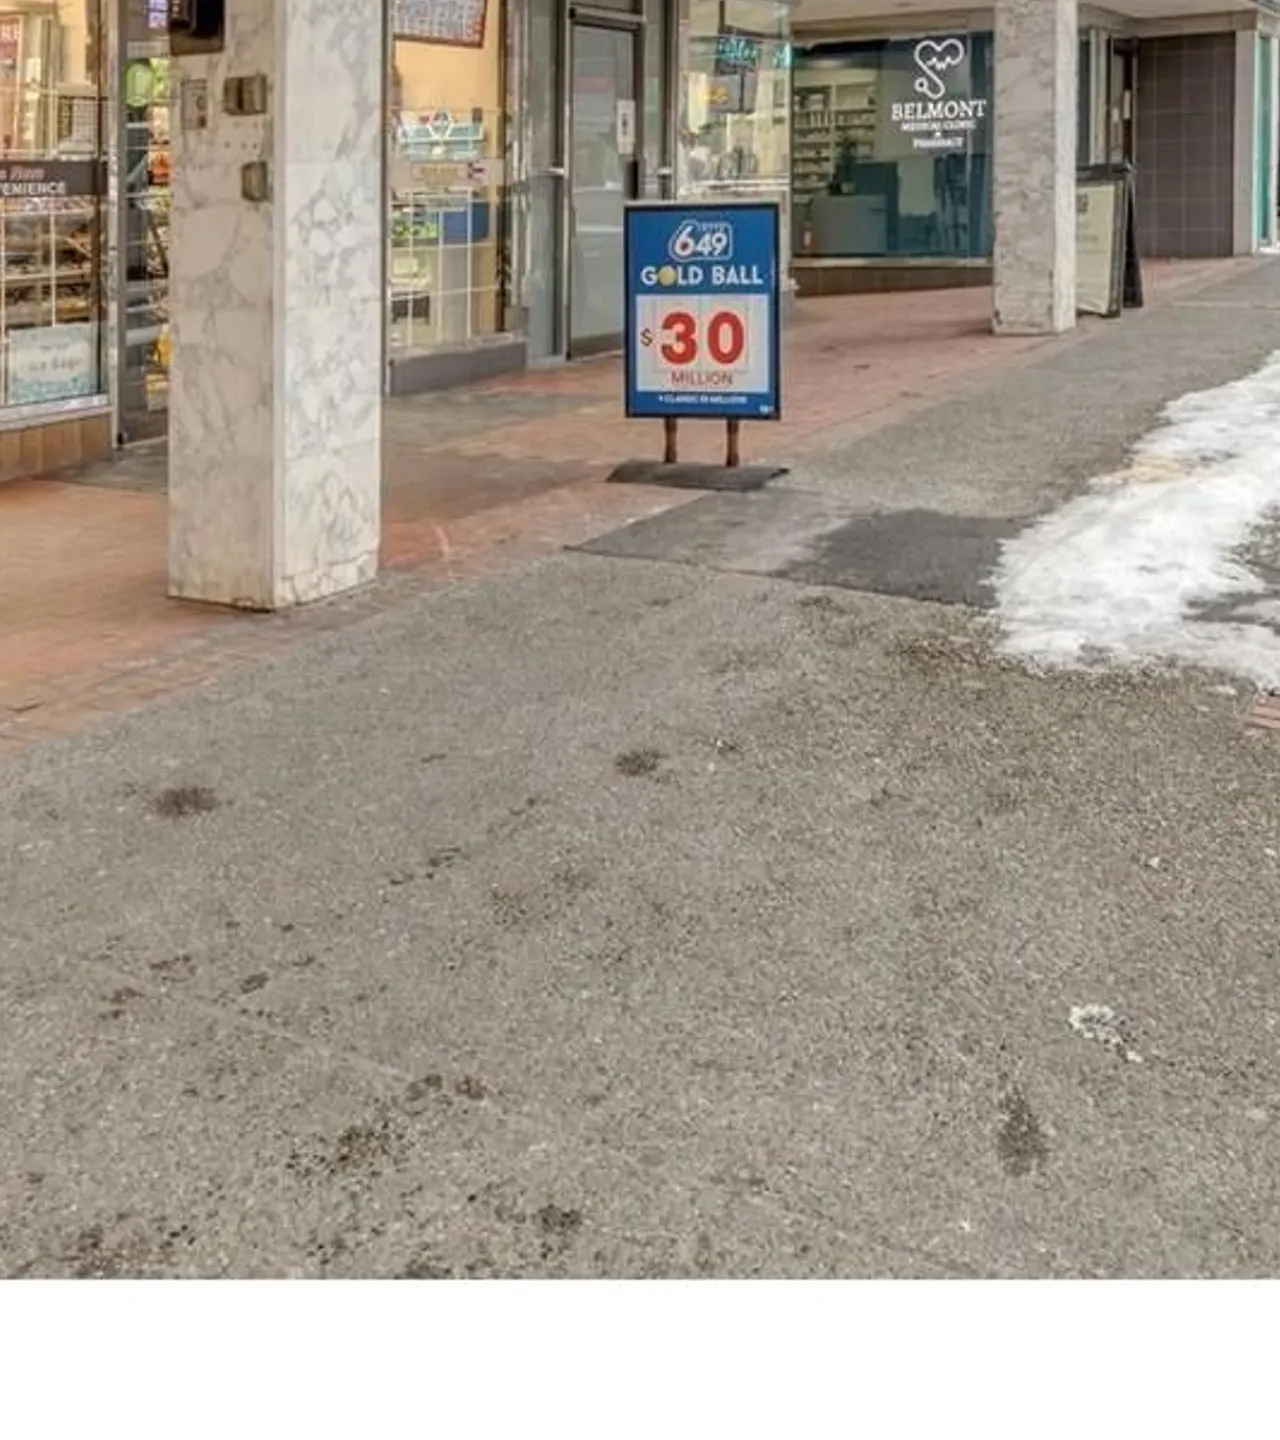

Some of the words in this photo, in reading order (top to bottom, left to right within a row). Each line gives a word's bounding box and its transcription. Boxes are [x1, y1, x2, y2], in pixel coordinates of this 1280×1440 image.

[891, 99, 987, 121] BELMONT
[673, 224, 729, 257] 649
[711, 265, 765, 286] BALL
[671, 372, 734, 386] MILLION
